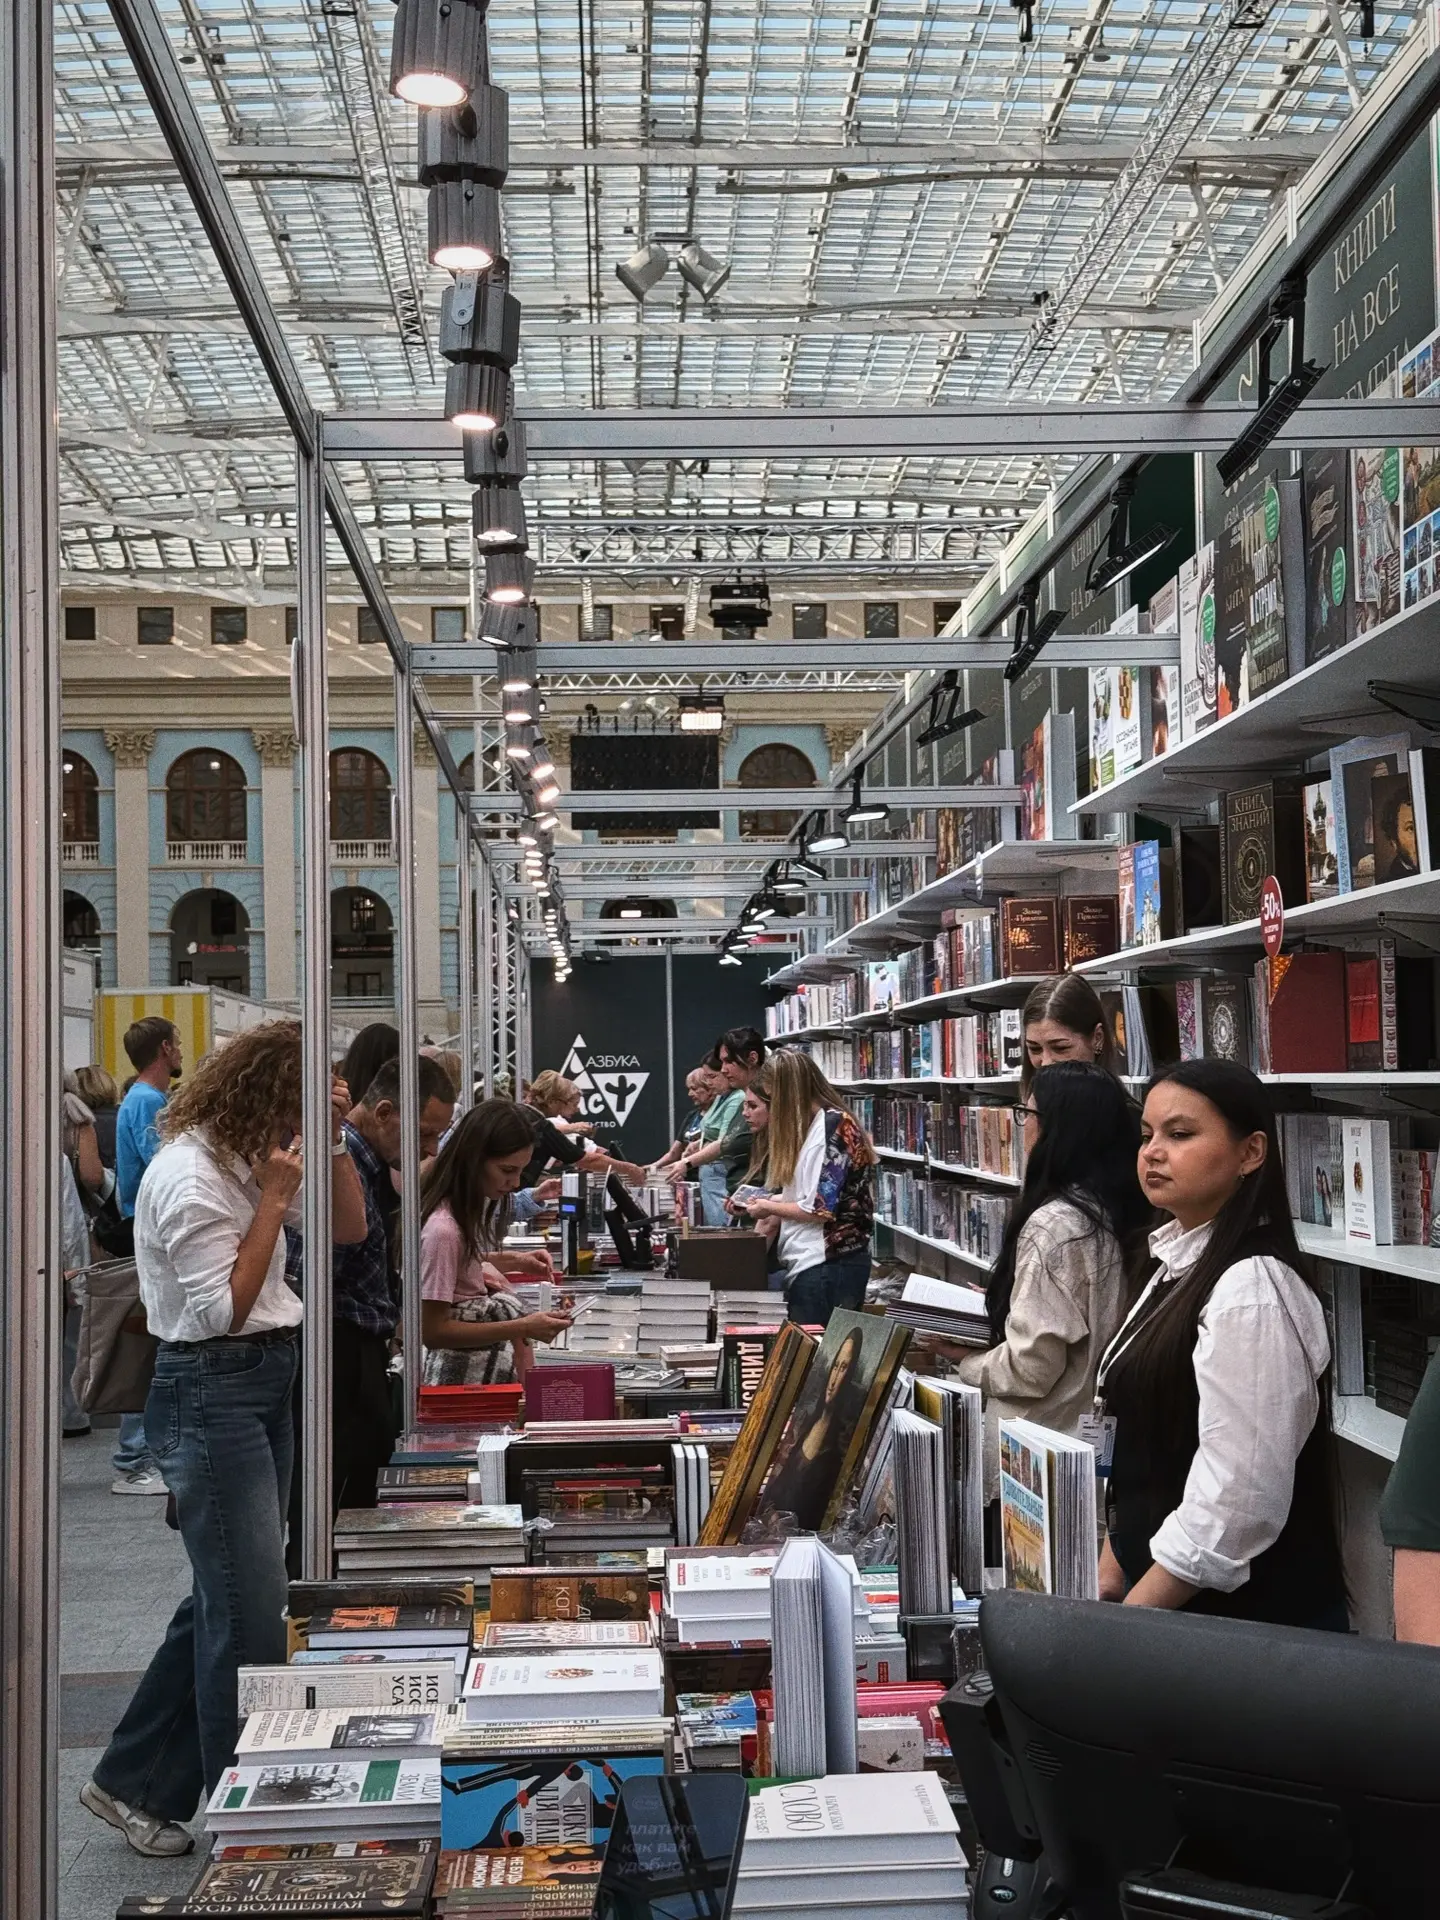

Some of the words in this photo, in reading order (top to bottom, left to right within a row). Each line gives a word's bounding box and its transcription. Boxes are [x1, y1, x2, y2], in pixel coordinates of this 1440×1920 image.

[1333, 183, 1397, 294] КНИГИ
[1333, 309, 1360, 370] НА
[1362, 263, 1401, 342] ВСЕ
[1234, 793, 1265, 814] КНИГА
[1231, 809, 1270, 833] ЗНАНИЙ
[1261, 892, 1281, 920] -50%
[586, 1055, 640, 1068] АЗБУКА
[737, 1342, 764, 1408] ДИНОЗ
[779, 1784, 826, 1831] СЛОВО
[621, 1843, 652, 1853] как
[471, 1855, 490, 1888] ЛИМОНОМ
[490, 1856, 507, 1886] ГНИЛЫМ
[510, 1856, 524, 1866] НЕ
[505, 1867, 524, 1884] БУДЬ
[181, 1903, 233, 1914] РУСЬ
[237, 1899, 365, 1912] ВОЛШЕБНАЯ
[187, 1894, 239, 1904] РУСЬ
[242, 1890, 368, 1904] ВОЛШЕБНАЯ
